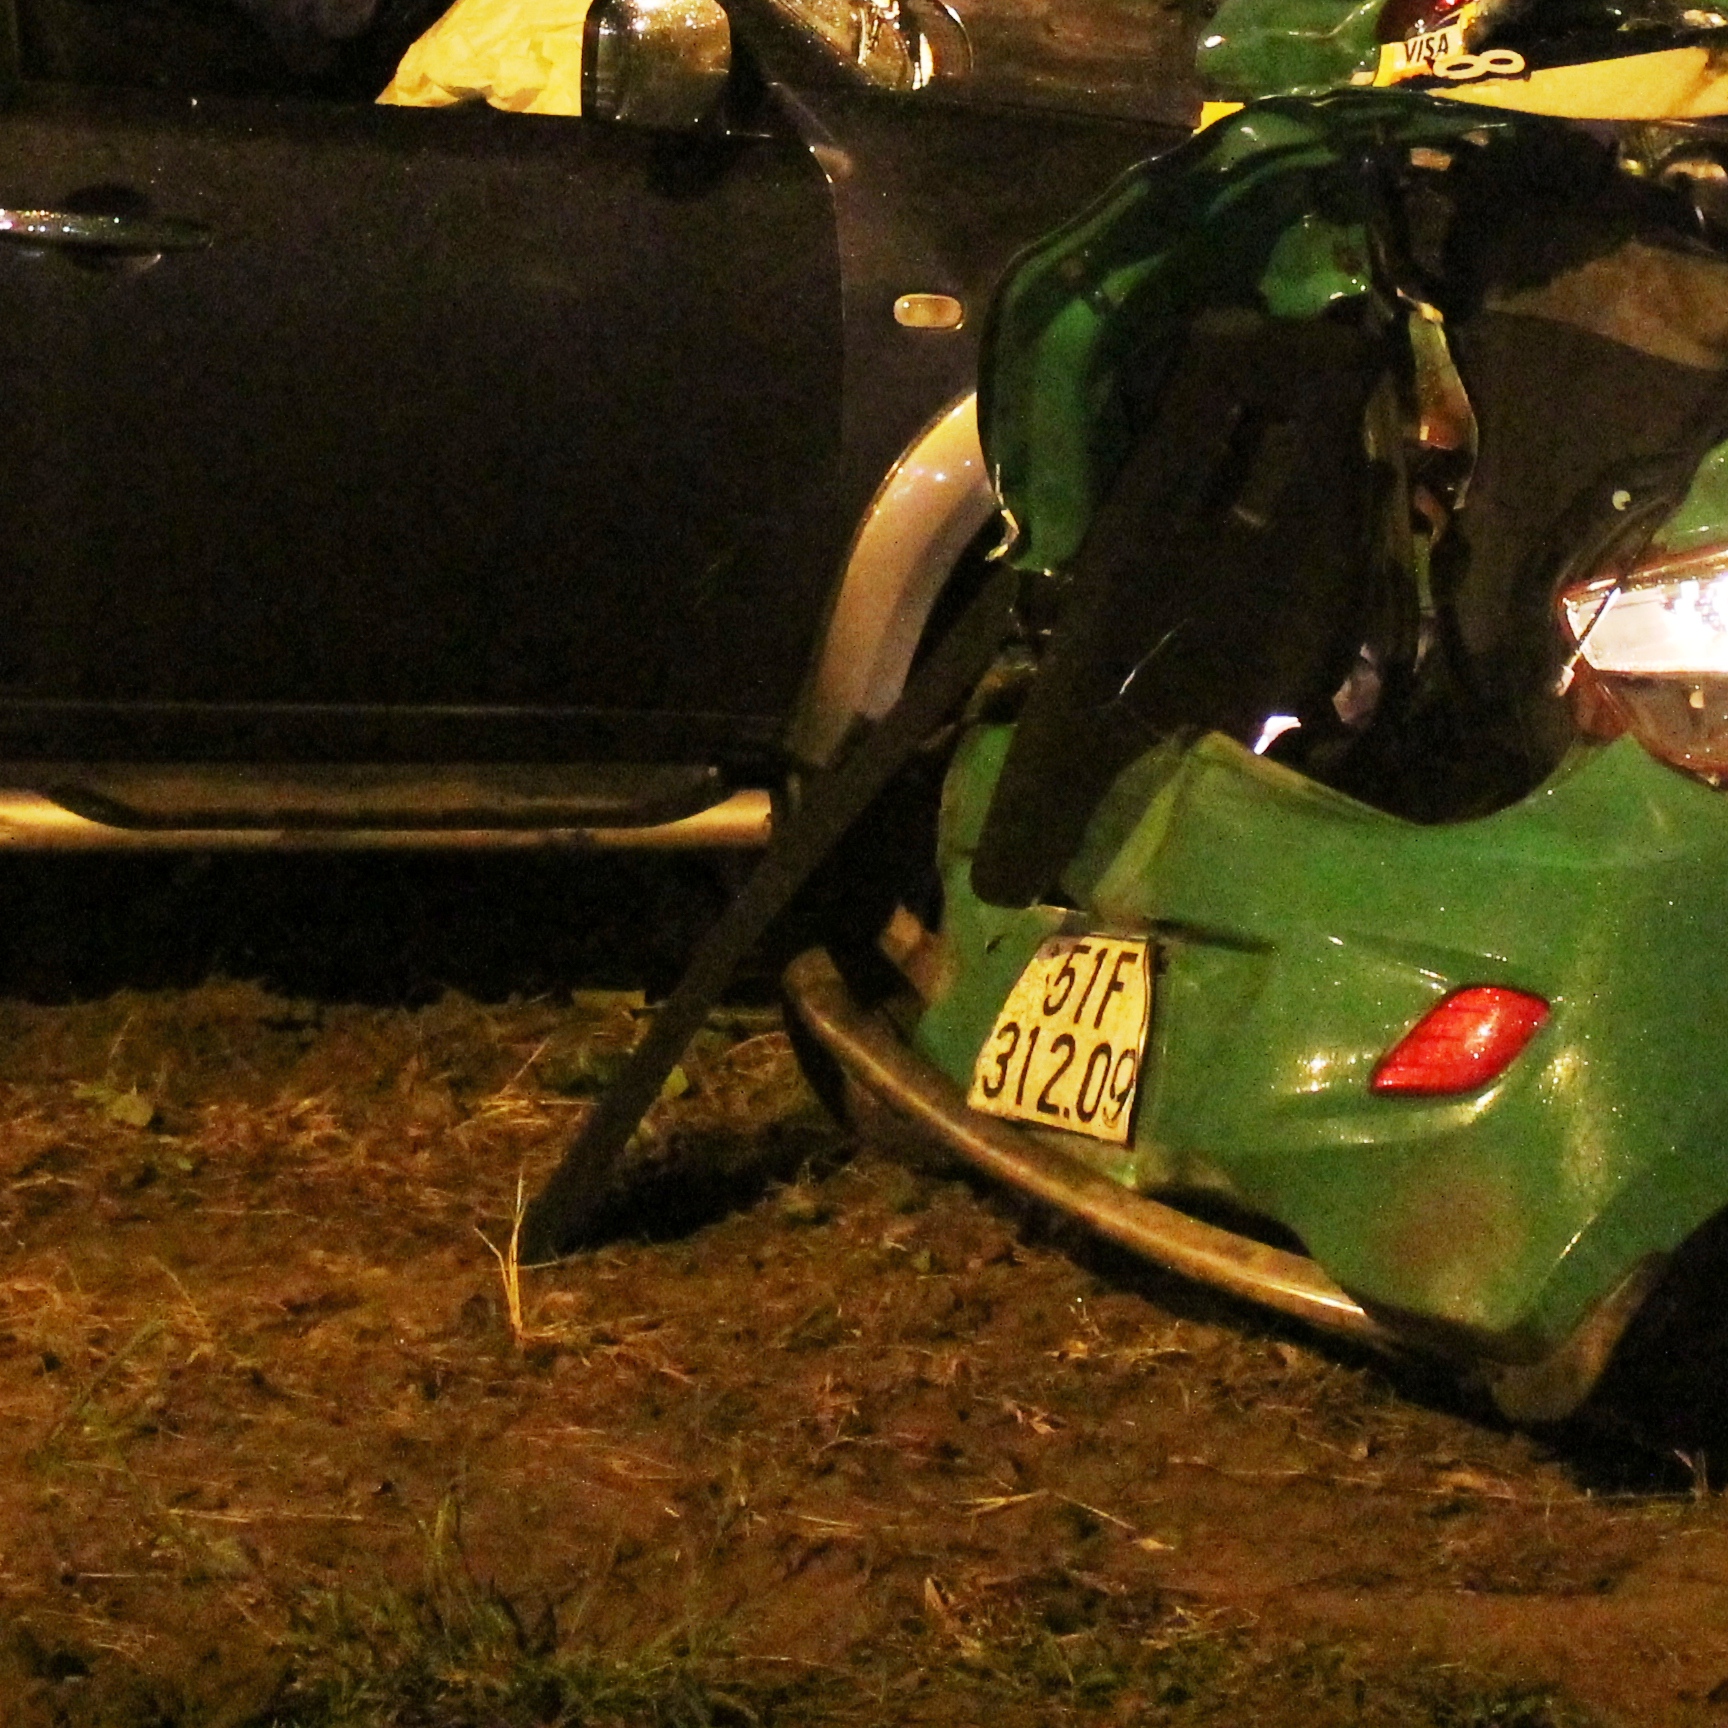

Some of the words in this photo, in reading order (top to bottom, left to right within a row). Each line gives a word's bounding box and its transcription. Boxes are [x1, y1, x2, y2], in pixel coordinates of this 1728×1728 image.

[1404, 33, 1449, 63] VISA
[1043, 944, 1139, 1029] 51F
[982, 1021, 1136, 1129] 312.09
